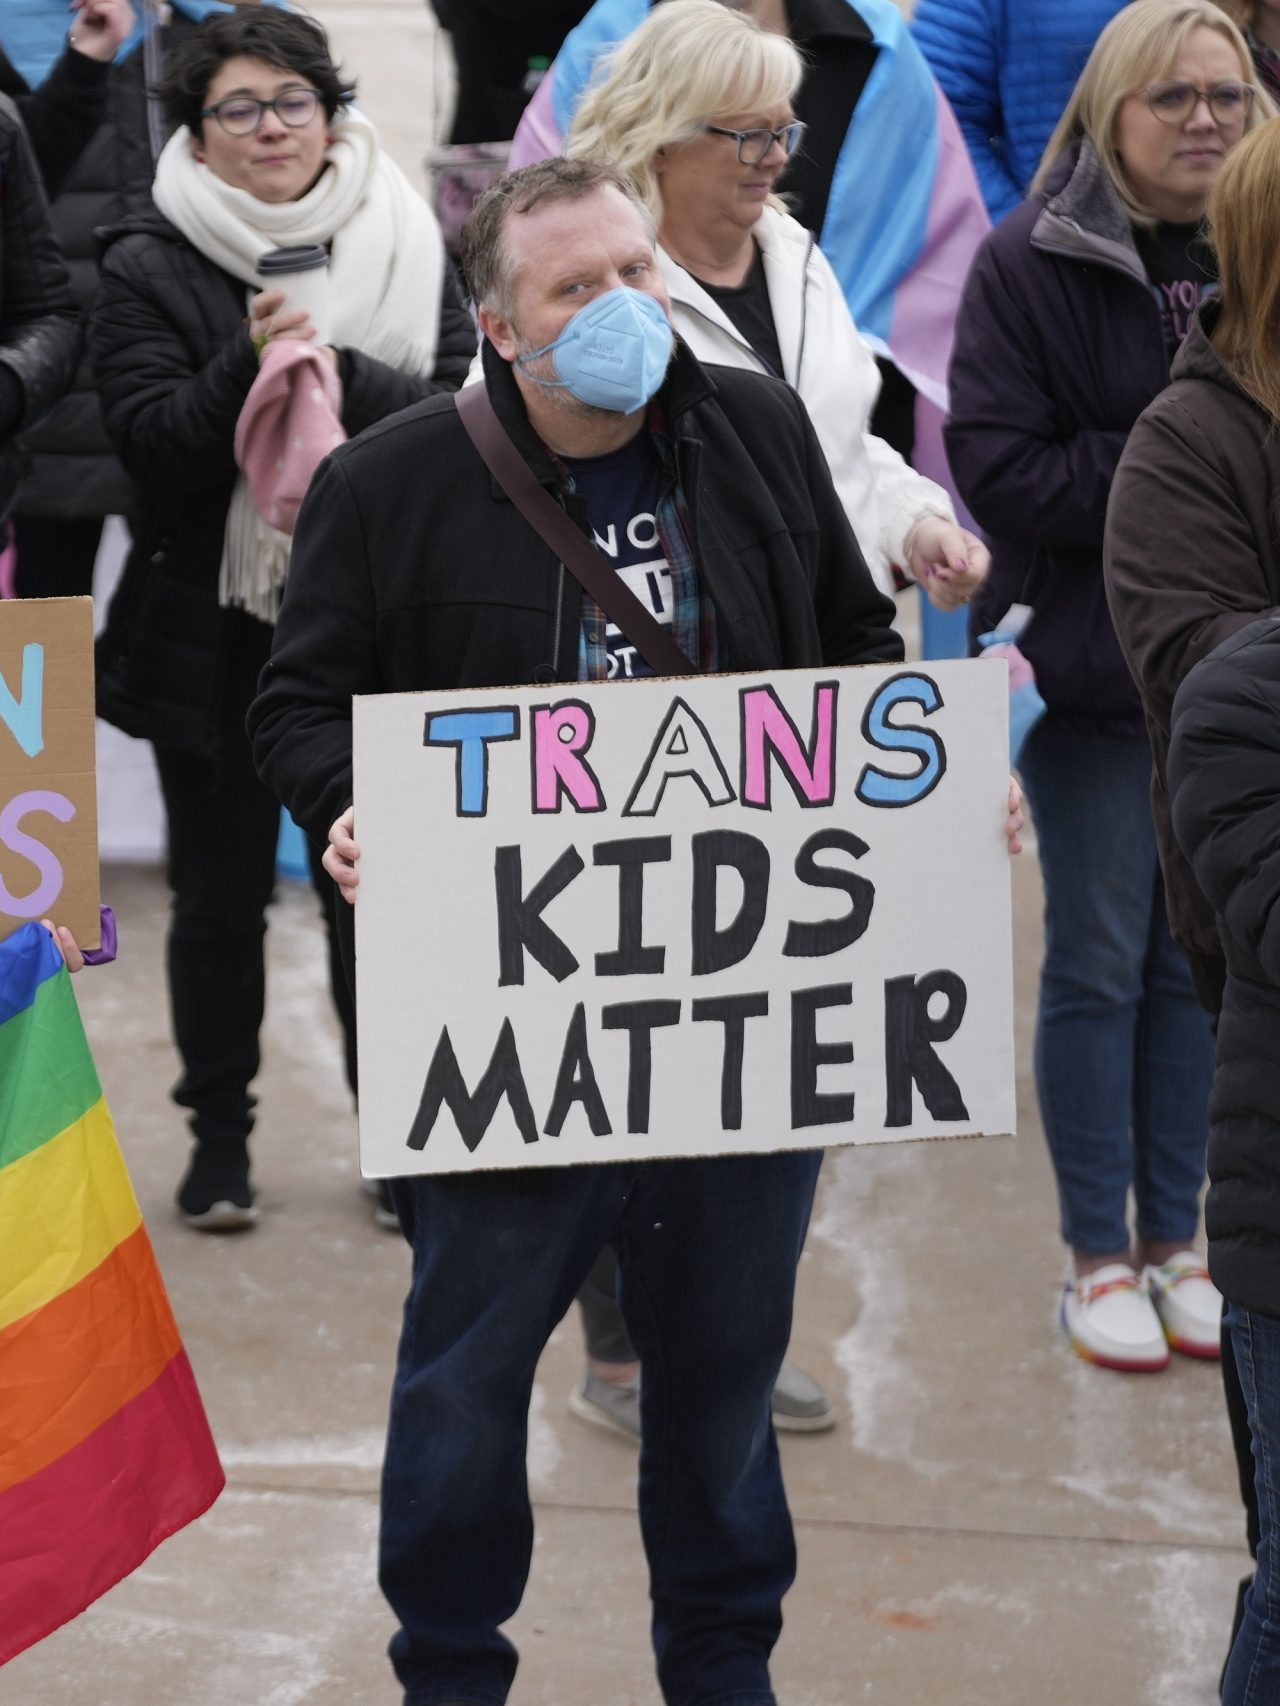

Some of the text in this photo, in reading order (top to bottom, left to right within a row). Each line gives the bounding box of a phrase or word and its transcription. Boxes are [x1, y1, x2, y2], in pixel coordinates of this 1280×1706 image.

[423, 671, 948, 818] TRANS
[494, 827, 876, 988] KIDS
[406, 968, 971, 1153] MATTER
